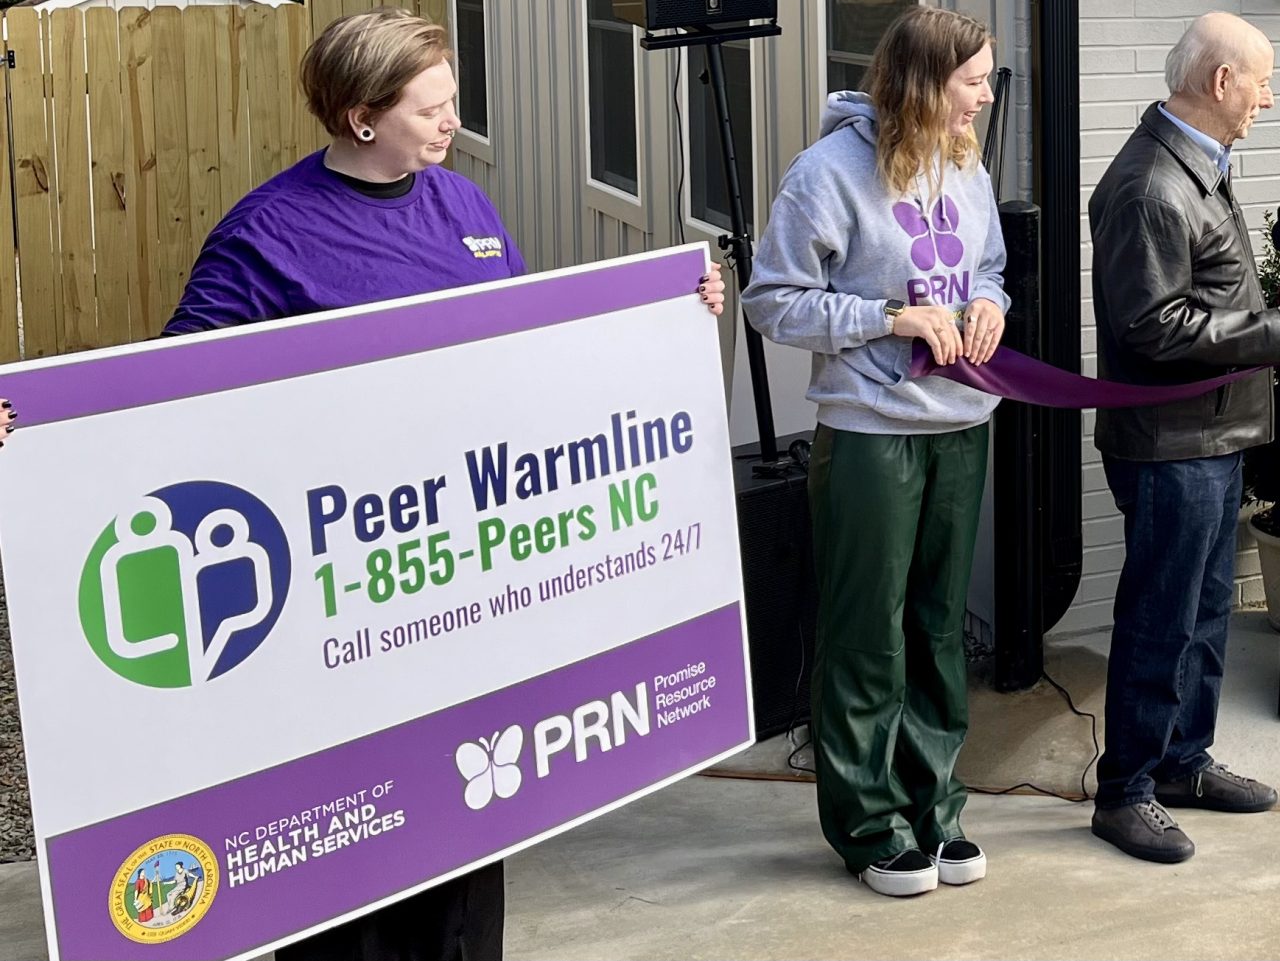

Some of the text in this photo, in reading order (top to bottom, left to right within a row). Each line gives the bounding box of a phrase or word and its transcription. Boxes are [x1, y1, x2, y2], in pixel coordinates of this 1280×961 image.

[907, 270, 969, 306] PRN
[306, 409, 694, 556] Peer Warmline
[314, 472, 660, 618] 1-855-Peers NC
[323, 522, 701, 669] Call someone who understands 24/7
[654, 661, 706, 692] Promise
[655, 676, 717, 710] Resource
[656, 694, 712, 728] Network
[533, 681, 651, 778] PRN
[225, 780, 394, 851] NC DEPARTMENT OF
[149, 840, 173, 854] STATE
[182, 840, 207, 861] NORTH
[226, 803, 375, 870] HEALTH AND
[228, 809, 406, 888] HUMAN SERVICES
[118, 871, 132, 888] SEAL
[199, 861, 214, 905] CAROLINA
[114, 890, 125, 917] GREAT
[121, 916, 134, 930] THE
